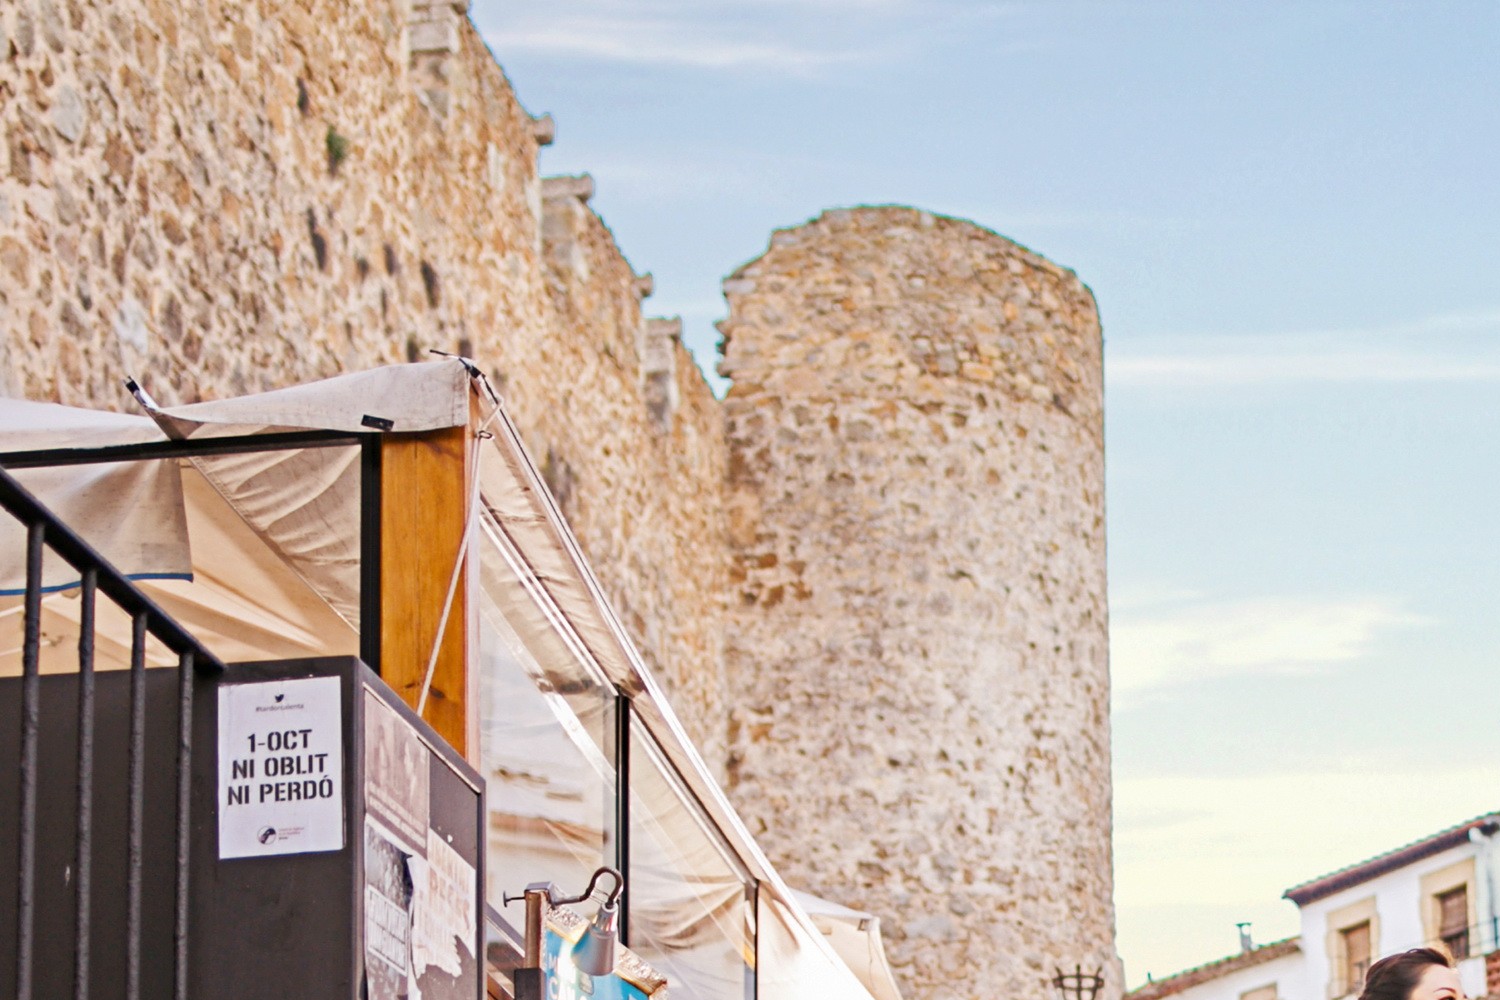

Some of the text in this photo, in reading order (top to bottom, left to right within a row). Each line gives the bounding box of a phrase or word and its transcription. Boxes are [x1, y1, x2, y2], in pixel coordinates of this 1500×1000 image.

[247, 729, 312, 753] 1-OCT
[232, 753, 328, 779] NI OBLIT
[228, 775, 333, 805] NI PERDÓ
